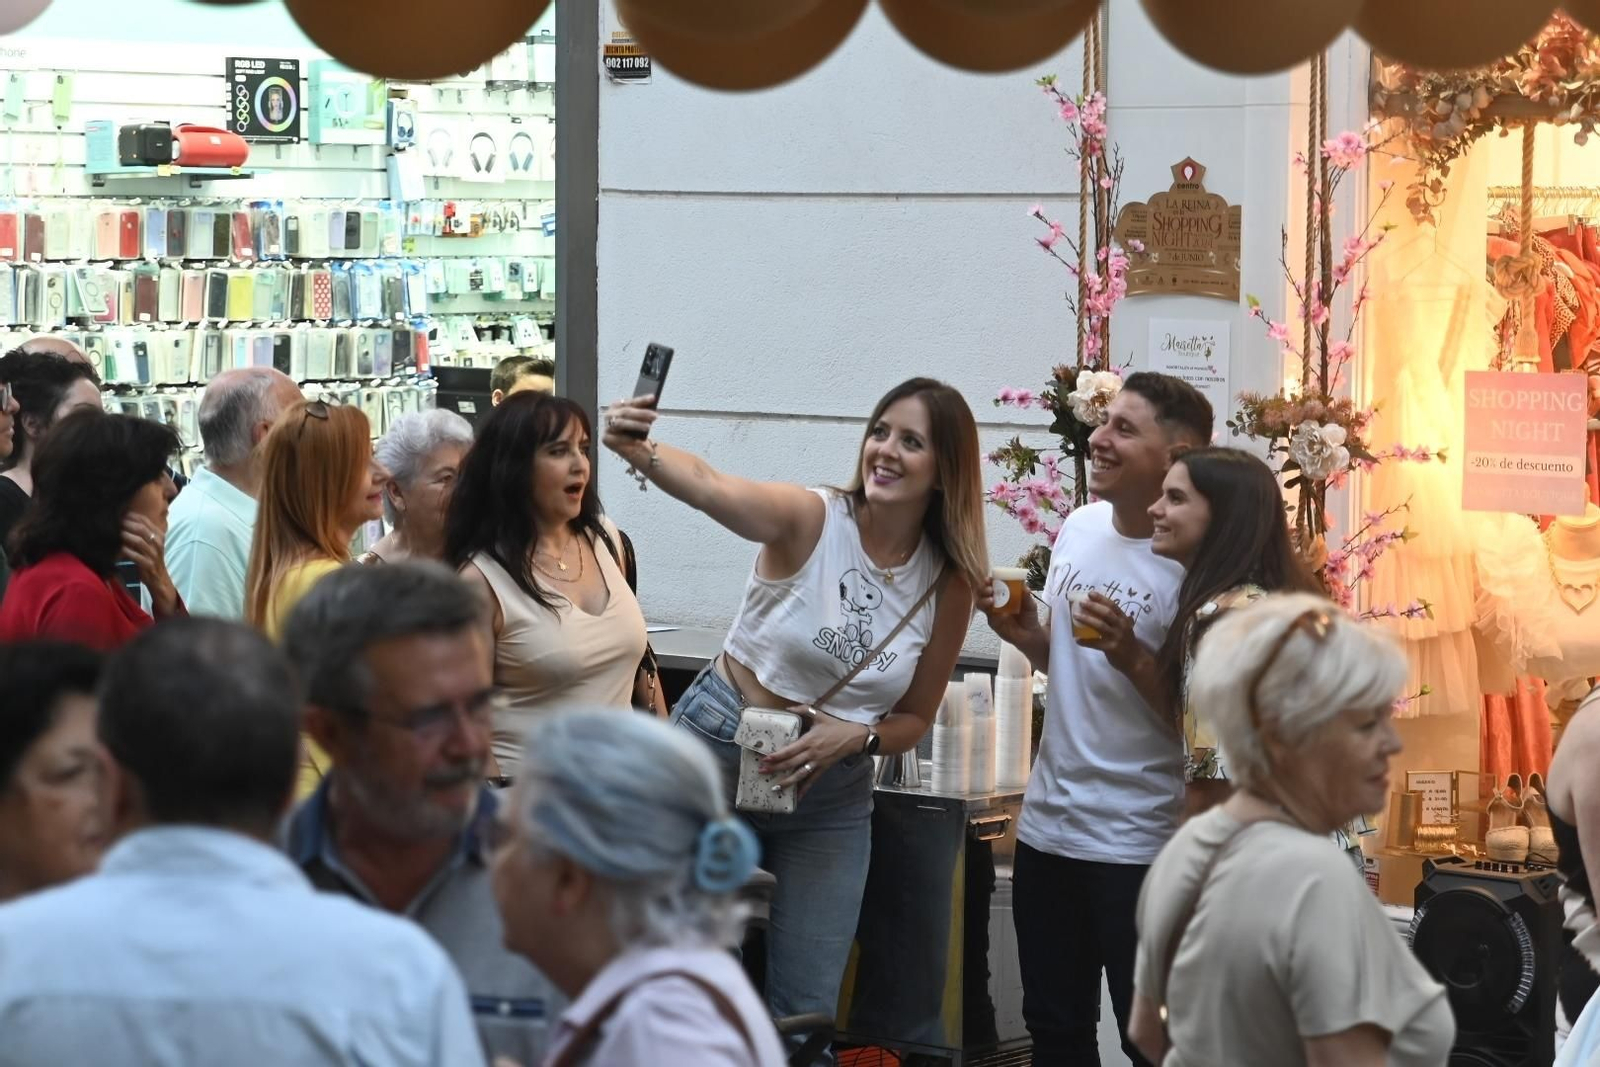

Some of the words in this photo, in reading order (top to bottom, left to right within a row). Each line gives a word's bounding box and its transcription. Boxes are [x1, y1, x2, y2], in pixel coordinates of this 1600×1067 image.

[251, 60, 265, 69] LED
[606, 57, 620, 68] 902
[622, 57, 633, 68] 117
[634, 57, 649, 68] 092
[1177, 182, 1200, 190] centro
[1165, 198, 1178, 209] LA
[1181, 199, 1211, 212] REINA
[1152, 212, 1222, 239] SHOPPING
[1151, 231, 1193, 248] NIGHT
[1180, 253, 1204, 262] JUNIO
[1469, 388, 1584, 412] SHOPPING
[1491, 420, 1565, 442] NIGHT
[1471, 456, 1496, 468] -20%
[1500, 458, 1513, 469] de
[1516, 458, 1574, 473] descuento
